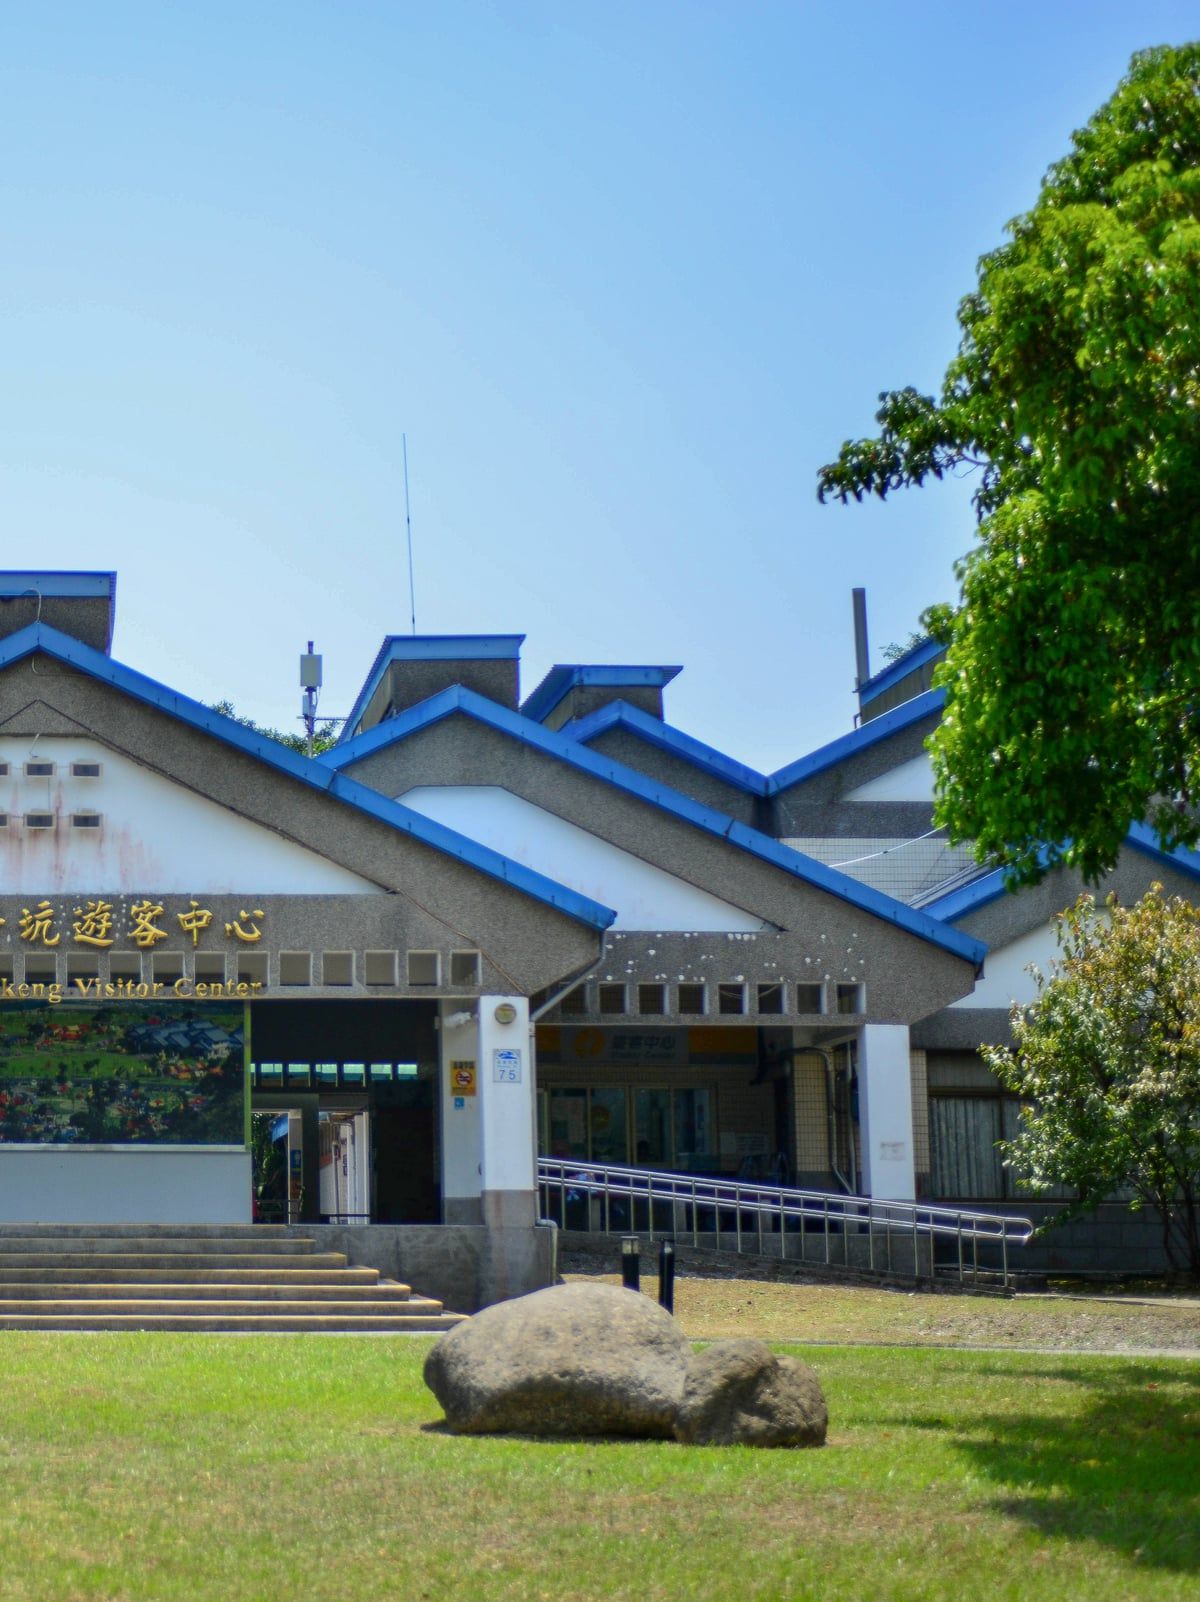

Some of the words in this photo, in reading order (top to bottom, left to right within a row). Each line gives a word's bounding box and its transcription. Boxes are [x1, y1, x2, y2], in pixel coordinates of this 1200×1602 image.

[73, 977, 165, 999] Visitor
[174, 978, 263, 999] Center
[498, 1069, 516, 1081] 75
